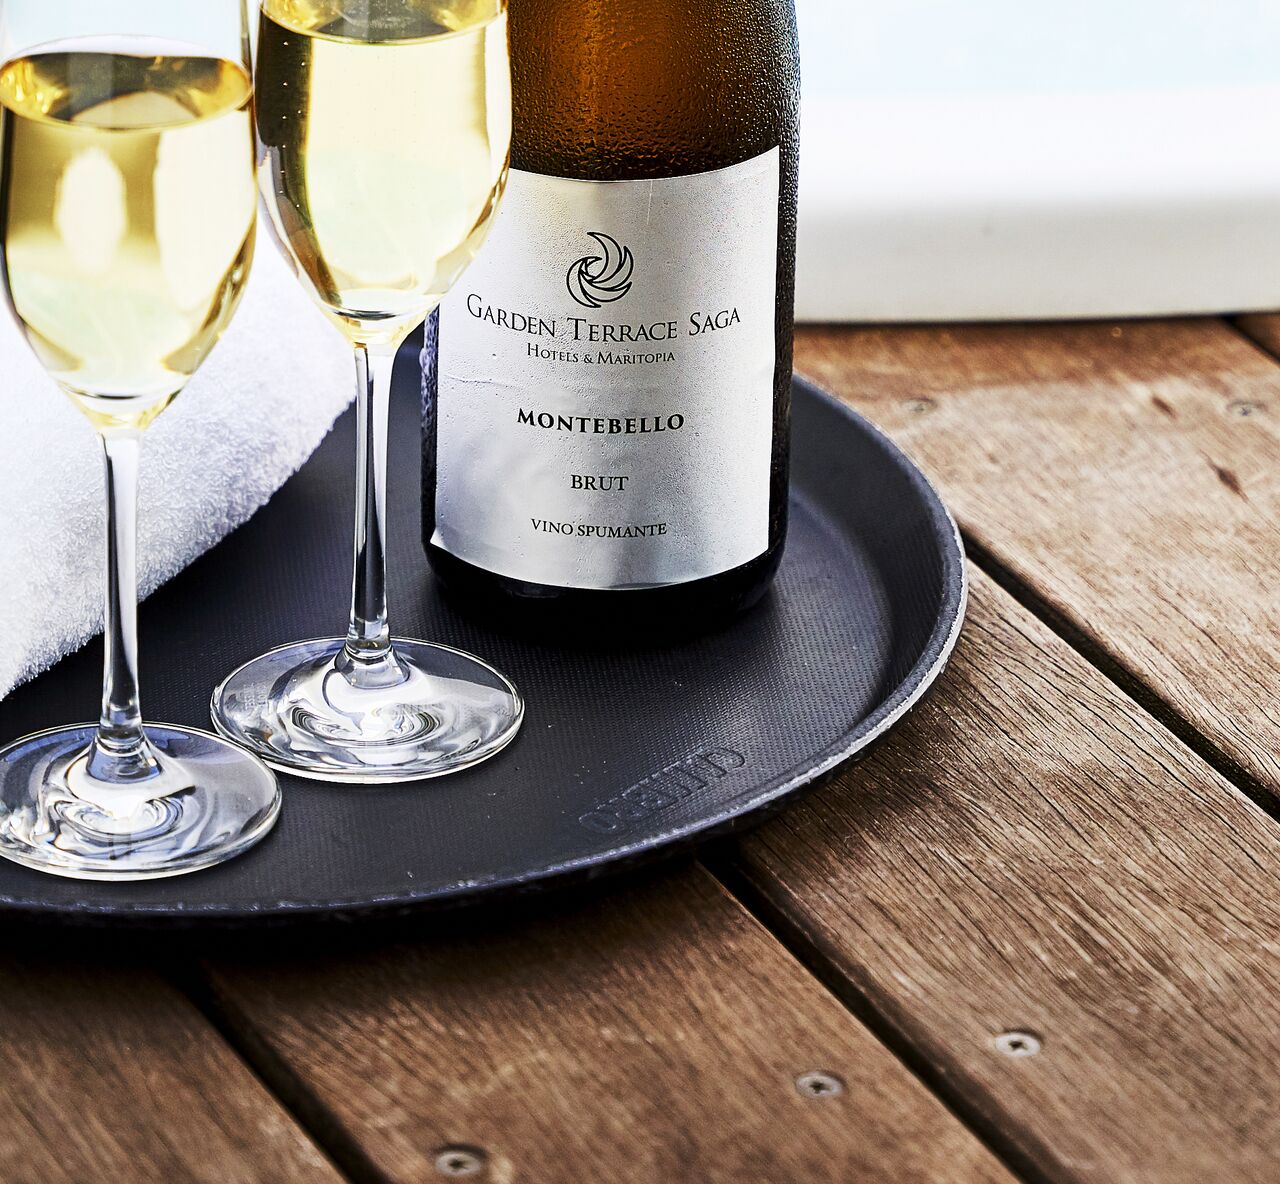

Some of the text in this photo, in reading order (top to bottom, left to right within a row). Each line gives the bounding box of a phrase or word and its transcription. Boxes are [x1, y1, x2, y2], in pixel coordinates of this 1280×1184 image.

[467, 294, 741, 343] GARDEN TERRACE SAGA
[526, 344, 675, 365] HOTELS & MARITOPIA
[517, 408, 684, 435] MONTEBELLO
[570, 474, 629, 491] BRUT
[531, 518, 667, 539] VINO SPUMANTE
